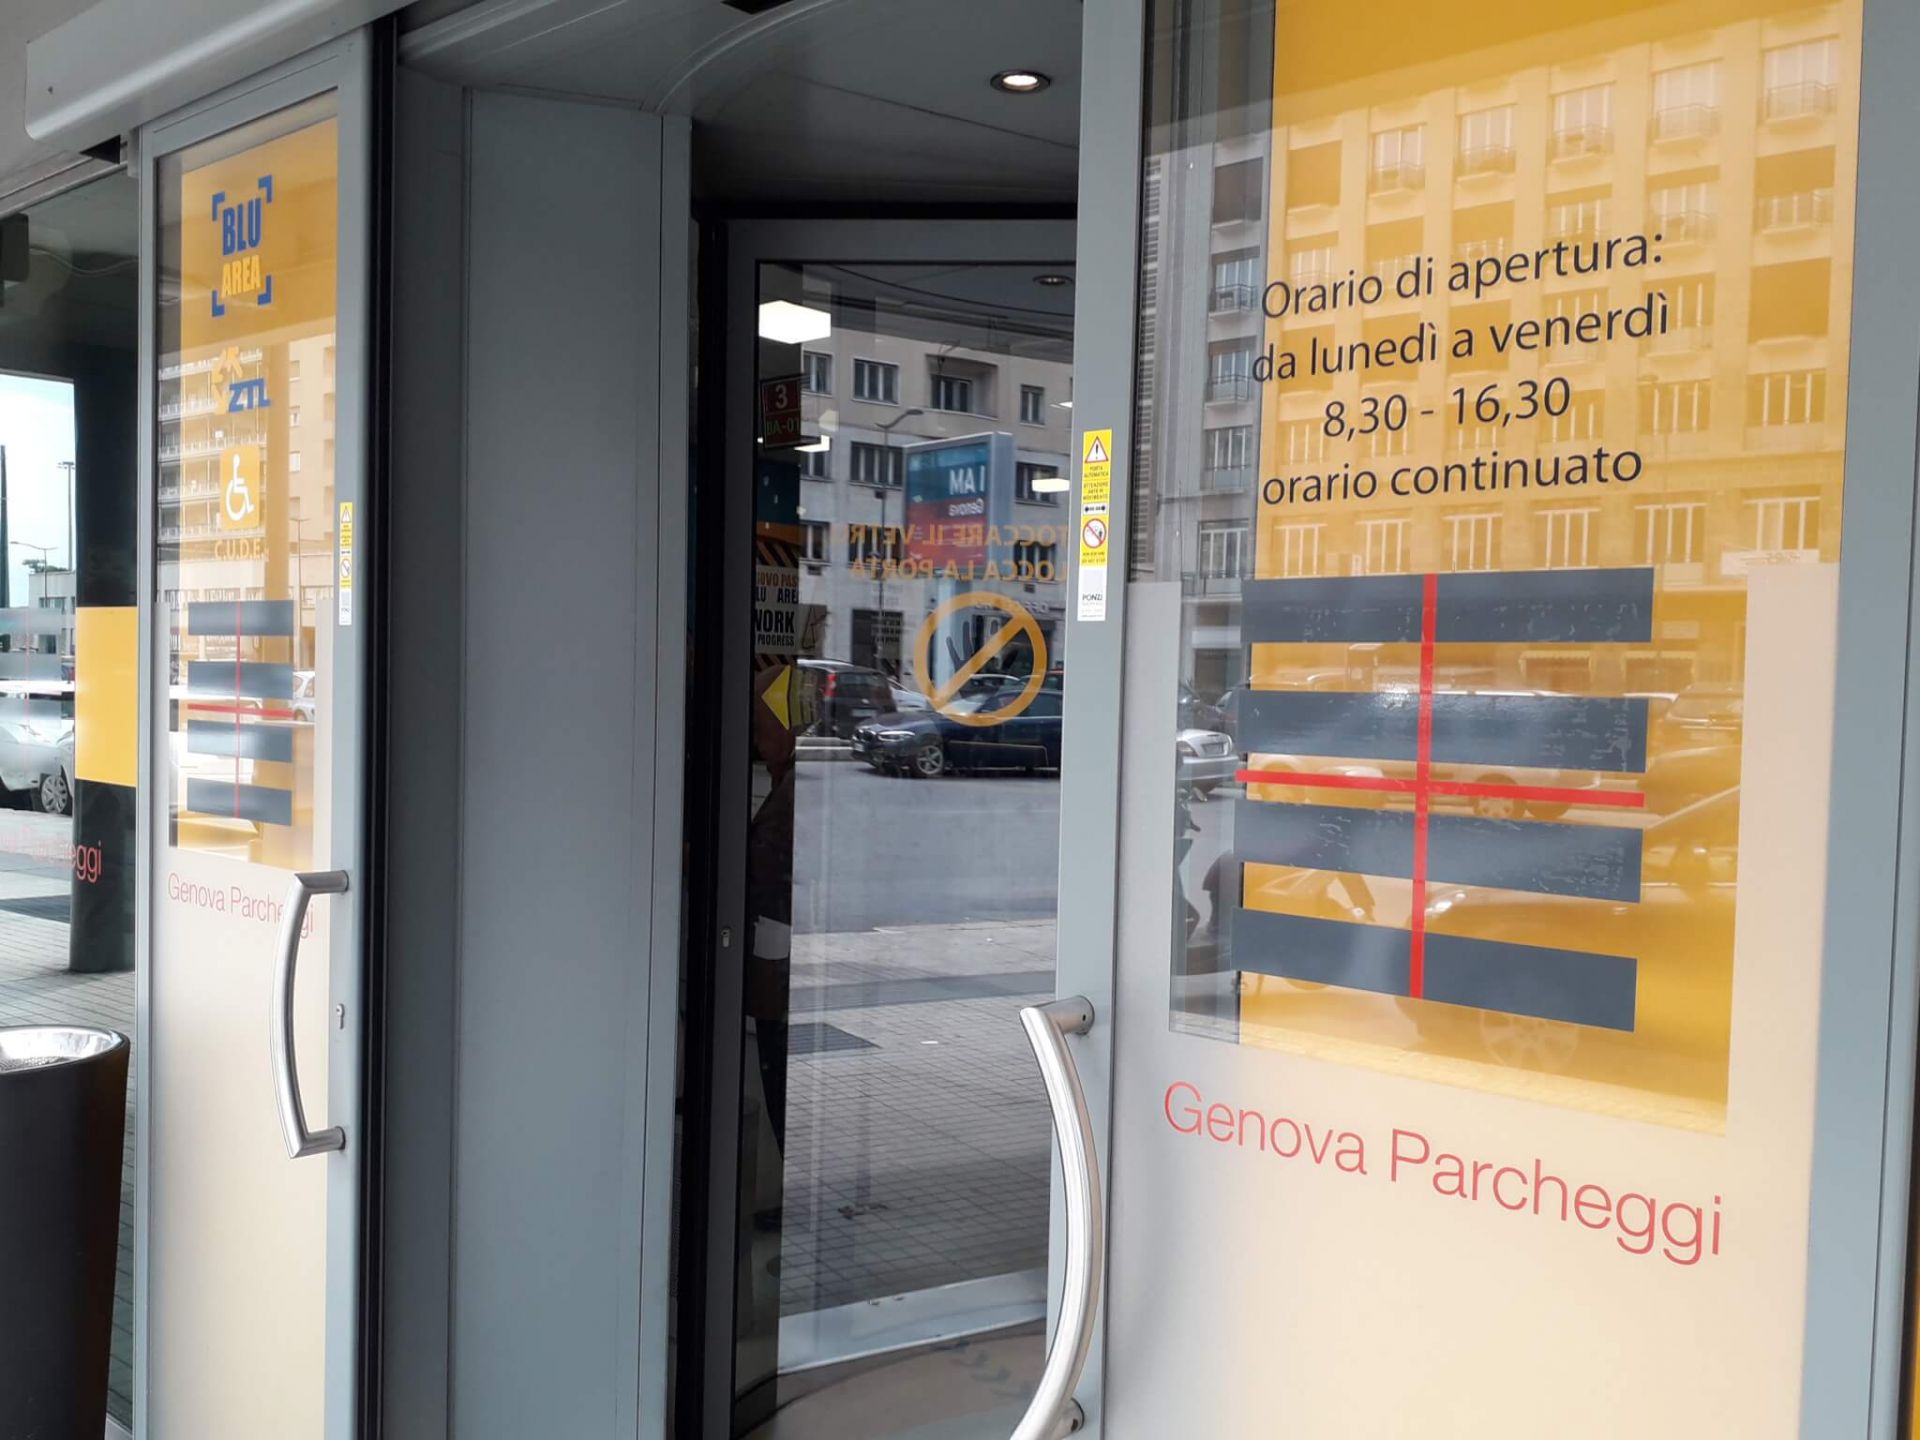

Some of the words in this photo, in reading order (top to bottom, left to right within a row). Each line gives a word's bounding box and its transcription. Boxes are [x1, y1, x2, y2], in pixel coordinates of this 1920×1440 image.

[223, 197, 262, 255] BLU
[222, 255, 261, 298] AREA
[1262, 269, 1382, 318] Orario
[1396, 256, 1434, 299] di
[1448, 233, 1663, 299] apertura:
[1252, 343, 1296, 383] da
[1310, 323, 1437, 376] lunedì
[1452, 328, 1474, 359] a
[1490, 292, 1669, 354] venerdì
[229, 378, 271, 413] ZTL
[775, 383, 788, 409] 3
[1323, 394, 1408, 441] 8,30
[1452, 376, 1571, 428] 16,30
[1263, 463, 1378, 505] orario
[1391, 446, 1642, 496] continuato
[777, 588, 799, 604] ARE
[168, 872, 226, 912] Genova
[230, 885, 314, 939] Parchegi
[1164, 1080, 1367, 1176] Genova
[1390, 1128, 1722, 1266] Parcheggi
